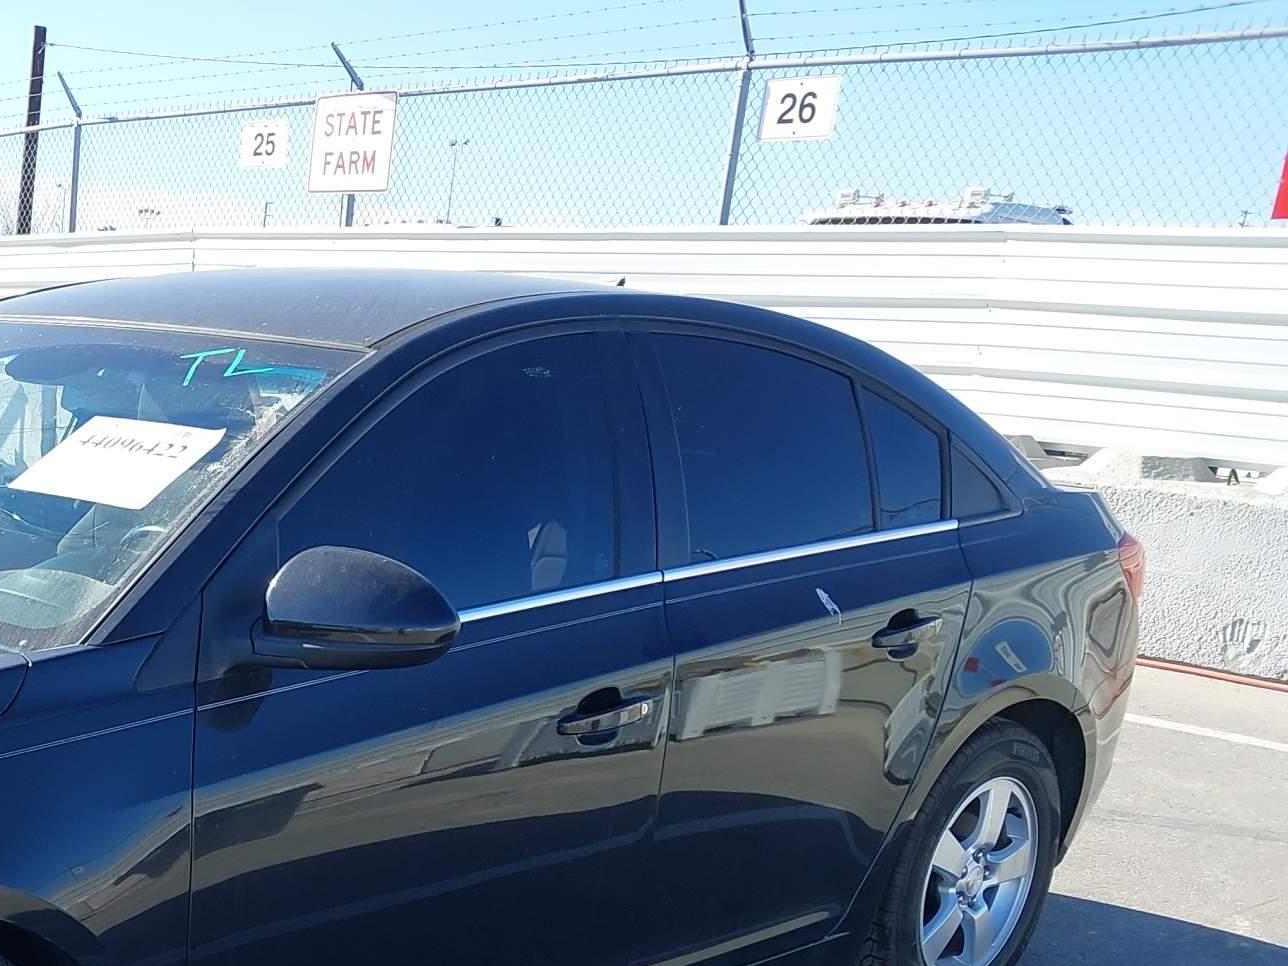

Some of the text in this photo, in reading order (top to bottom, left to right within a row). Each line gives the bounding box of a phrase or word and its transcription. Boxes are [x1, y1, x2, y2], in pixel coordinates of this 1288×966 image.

[776, 91, 818, 125] 26
[323, 109, 384, 137] STATE
[252, 132, 276, 157] 25
[322, 149, 377, 176] FARM
[179, 346, 275, 387] TL
[79, 433, 189, 459] 44096422
